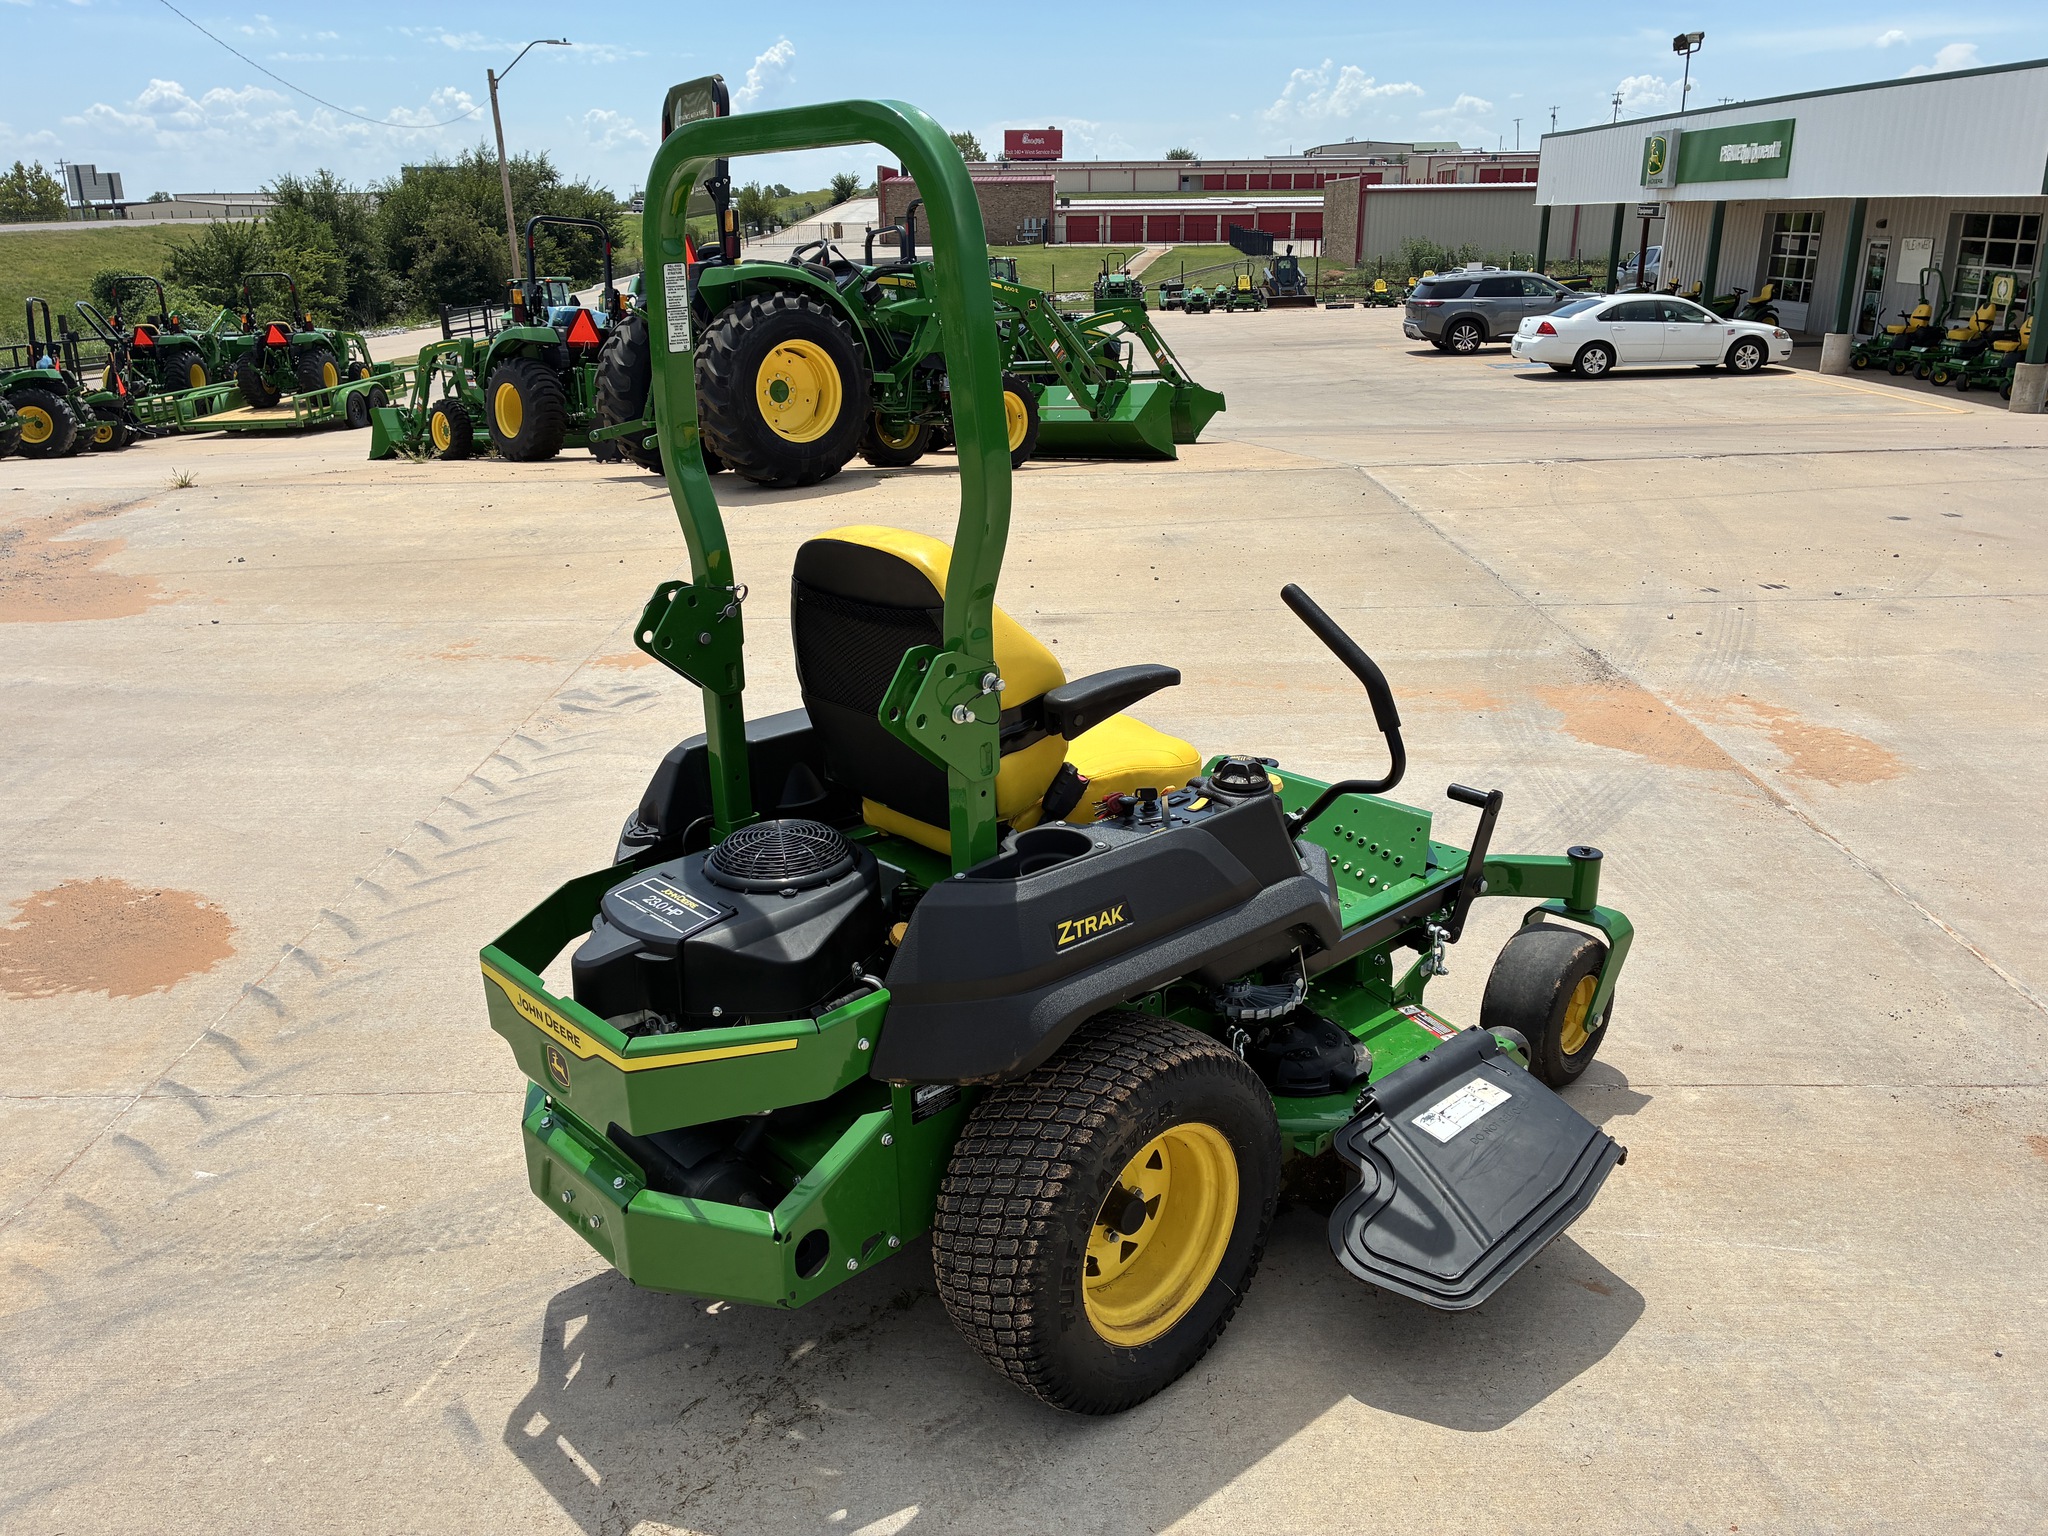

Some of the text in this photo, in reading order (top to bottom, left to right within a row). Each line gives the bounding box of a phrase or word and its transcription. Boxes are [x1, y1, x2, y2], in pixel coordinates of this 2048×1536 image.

[661, 905, 684, 916] HP
[1057, 904, 1124, 945] ZTRAK
[517, 993, 582, 1050] JOHN DEERE
[1469, 1134, 1485, 1146] DO
[1484, 1120, 1502, 1135] NOT
